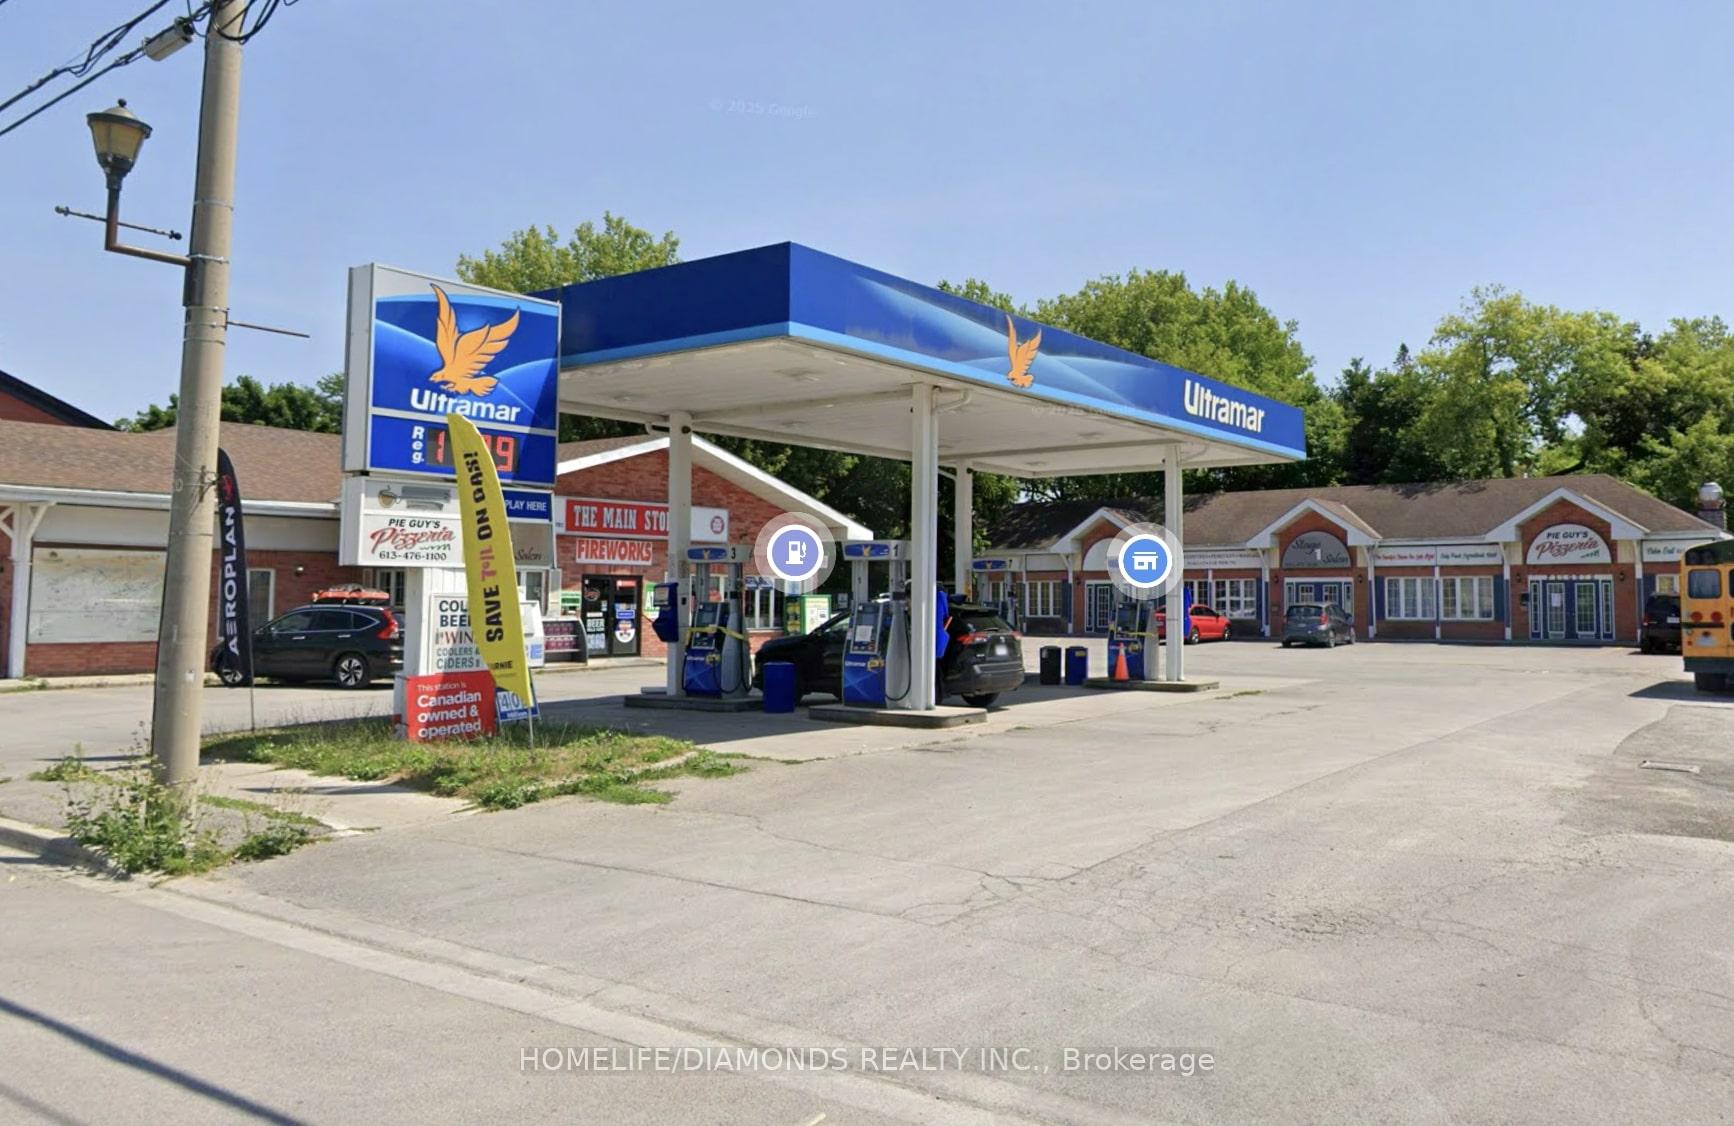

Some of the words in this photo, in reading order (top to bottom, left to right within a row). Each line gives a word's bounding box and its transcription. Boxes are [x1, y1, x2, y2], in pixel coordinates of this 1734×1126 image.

[410, 388, 520, 423] Ultramar
[1183, 380, 1265, 433] Ultramar
[505, 500, 525, 510] PLAY
[526, 501, 547, 511] HERE
[388, 518, 407, 528] PIE
[409, 519, 441, 529] GUY'S
[476, 508, 493, 540] ON
[573, 505, 597, 528] THE
[603, 508, 636, 529] MAIN
[644, 510, 670, 532] STO
[370, 526, 456, 554] Pizzeria
[1562, 531, 1588, 539] GUY'S
[379, 551, 447, 561] 613-476-1100
[576, 539, 652, 562] FIREWORKS
[731, 547, 736, 560] 3
[1536, 537, 1599, 559] Pizzeria
[224, 506, 240, 656] AEROPLAN
[439, 600, 468, 613] COL
[483, 585, 504, 642] SAVE
[445, 630, 474, 644] WIN
[436, 657, 474, 669] CIDERS
[417, 691, 482, 708] Canadian
[417, 705, 467, 723] owned
[470, 704, 479, 718] &
[418, 719, 481, 739] operated
